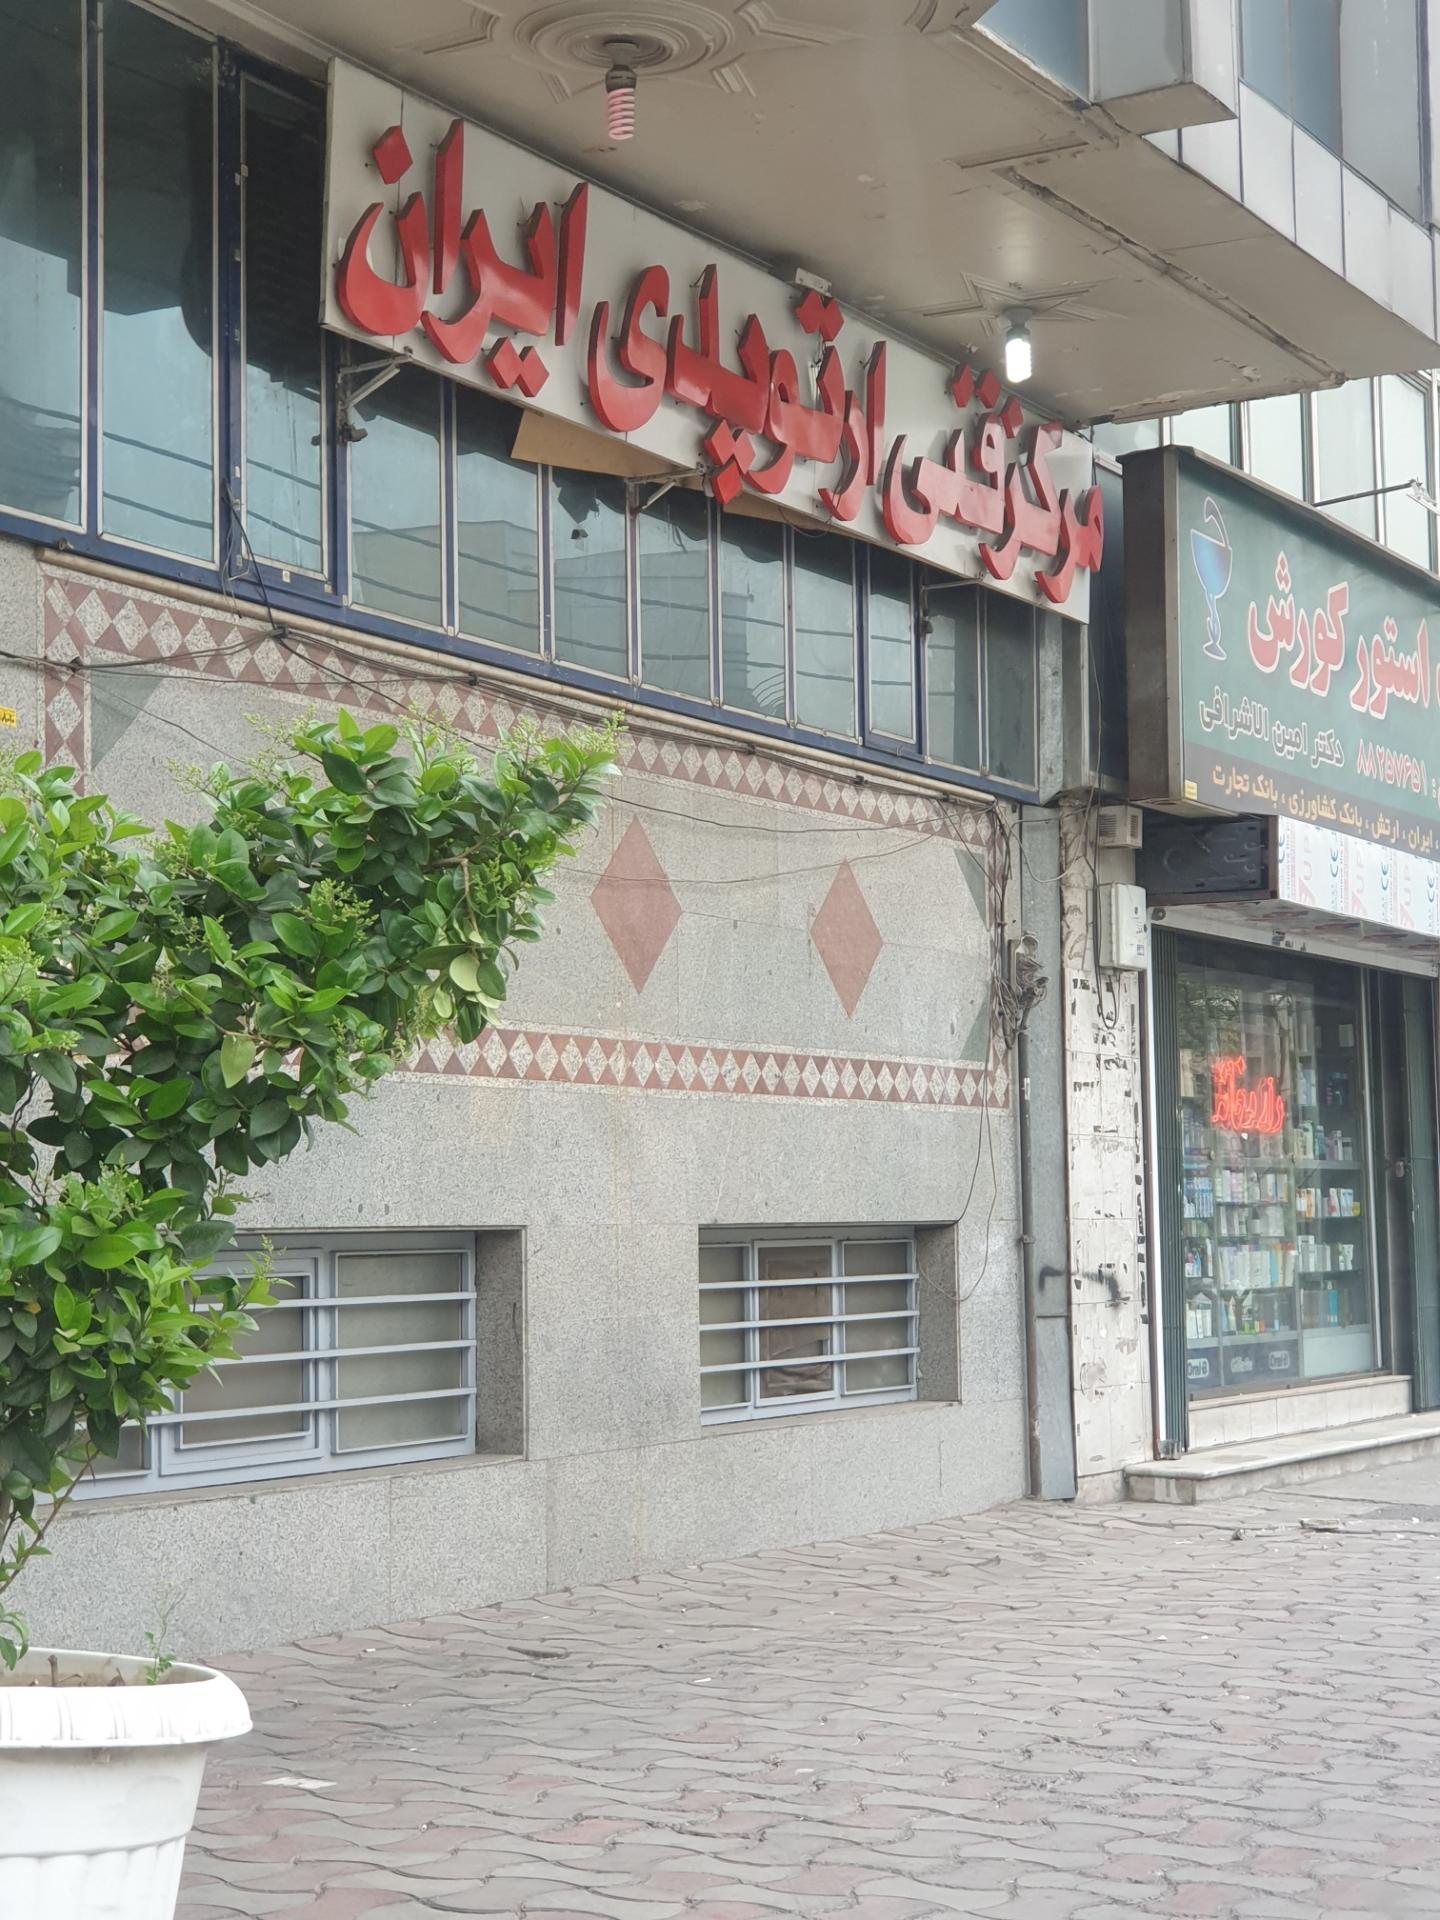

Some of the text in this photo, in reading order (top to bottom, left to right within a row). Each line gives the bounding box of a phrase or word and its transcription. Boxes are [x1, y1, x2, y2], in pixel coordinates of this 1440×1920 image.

[338, 119, 1104, 603] مرکز فنی ارتوپدی ایران
[1248, 551, 1430, 720] استور کورش
[1272, 720, 1308, 760] امین
[1311, 729, 1344, 768] دکتر
[1212, 765, 1249, 798] تجارت
[1253, 774, 1278, 806] بانک
[1339, 803, 1362, 833] بانک
